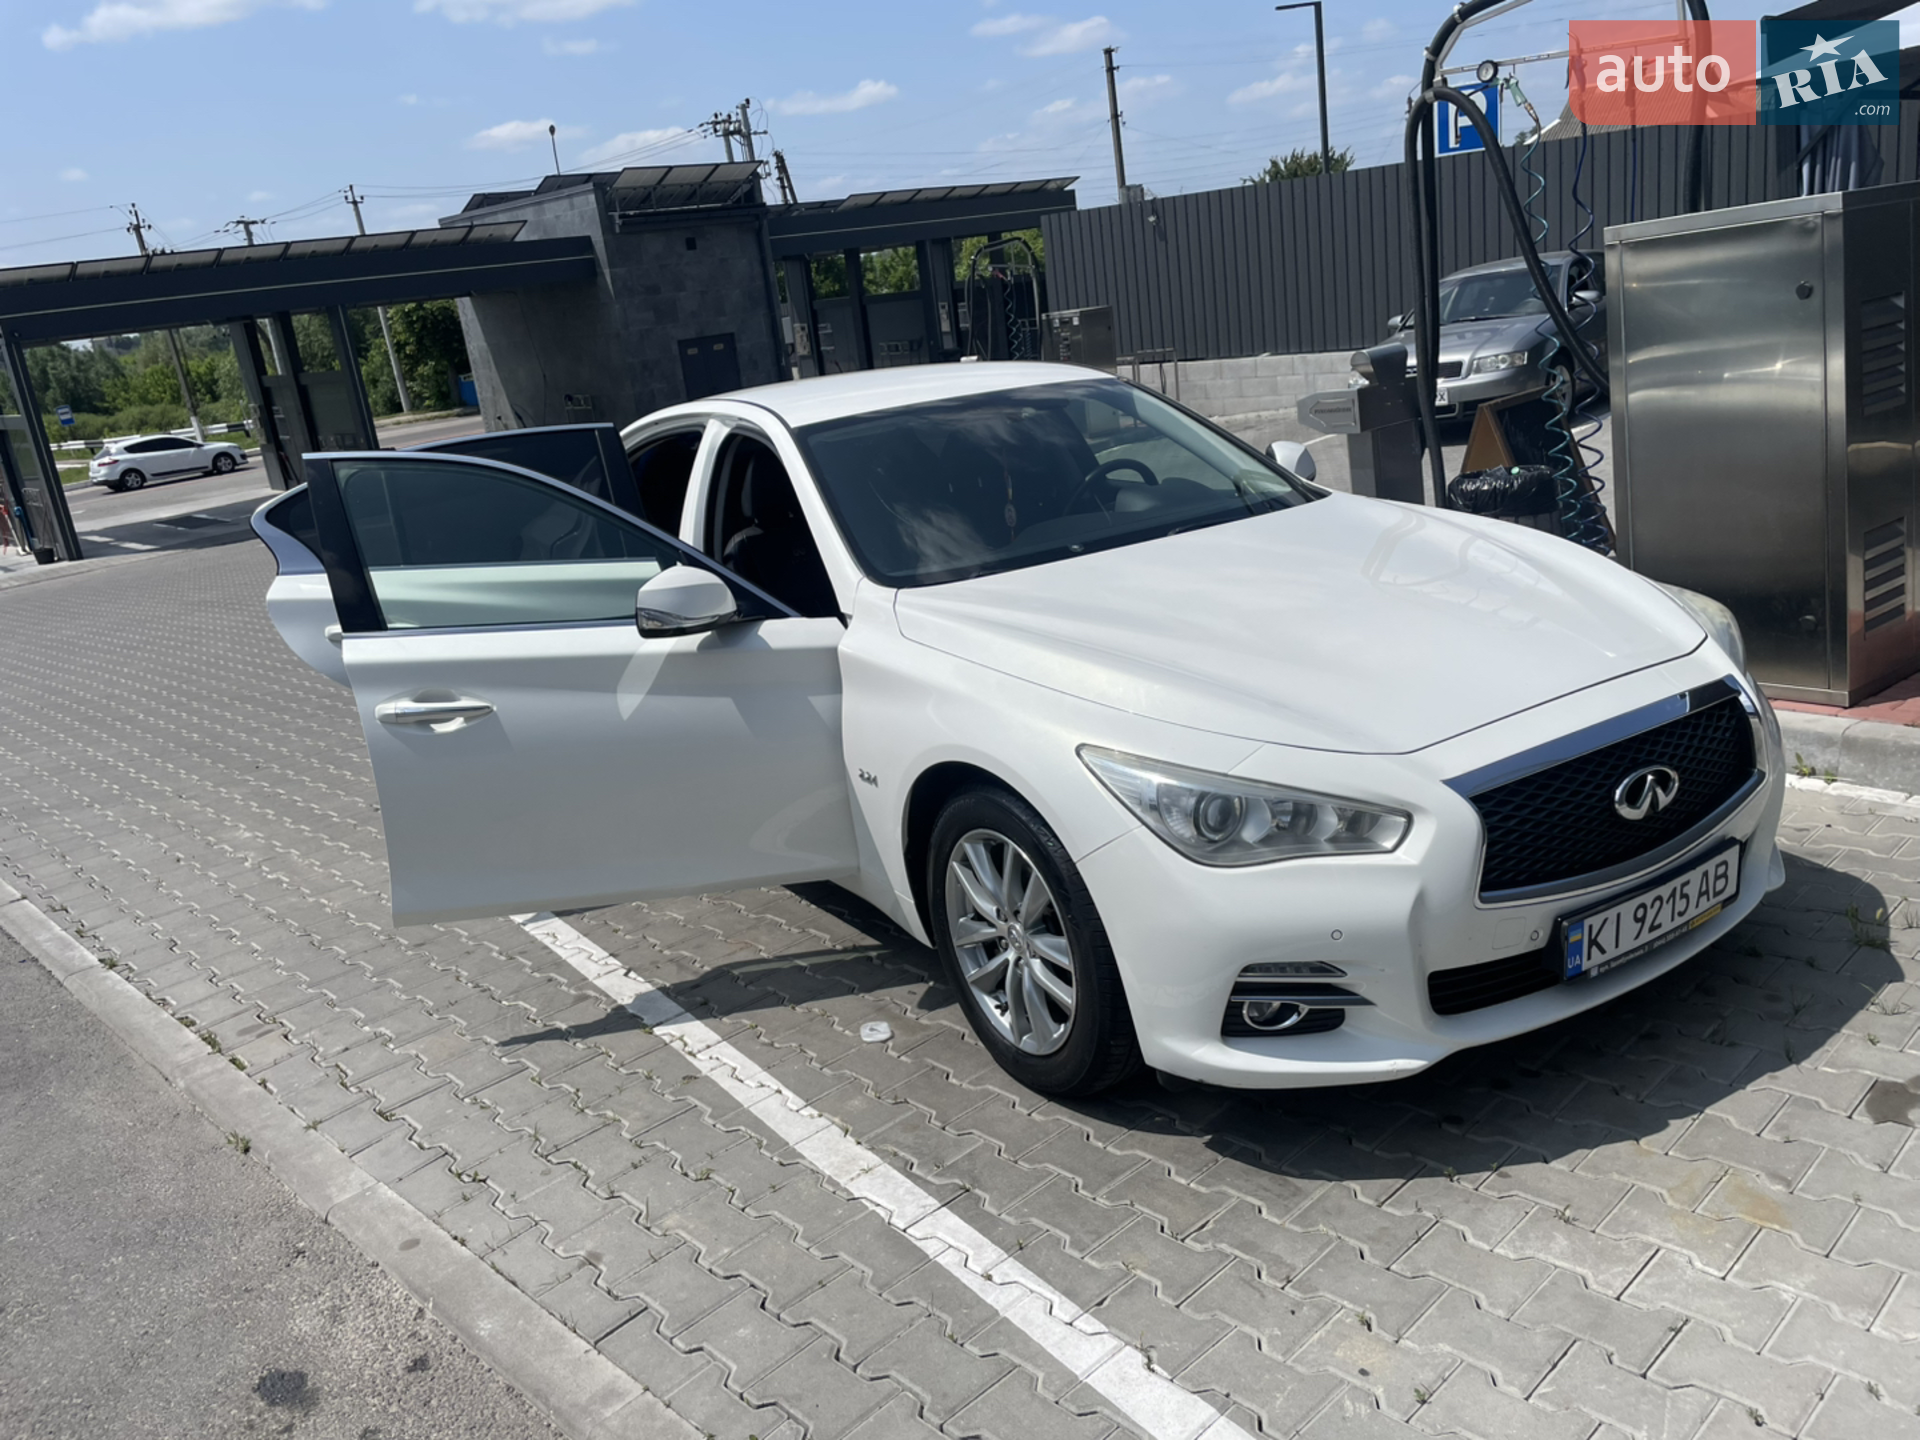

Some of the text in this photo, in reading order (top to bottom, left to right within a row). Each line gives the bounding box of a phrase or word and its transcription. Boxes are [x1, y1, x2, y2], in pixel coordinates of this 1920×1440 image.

[1586, 912, 1621, 962] KI
[1633, 879, 1691, 941] 9215
[1695, 859, 1729, 909] AB
[1567, 954, 1582, 969] UA
